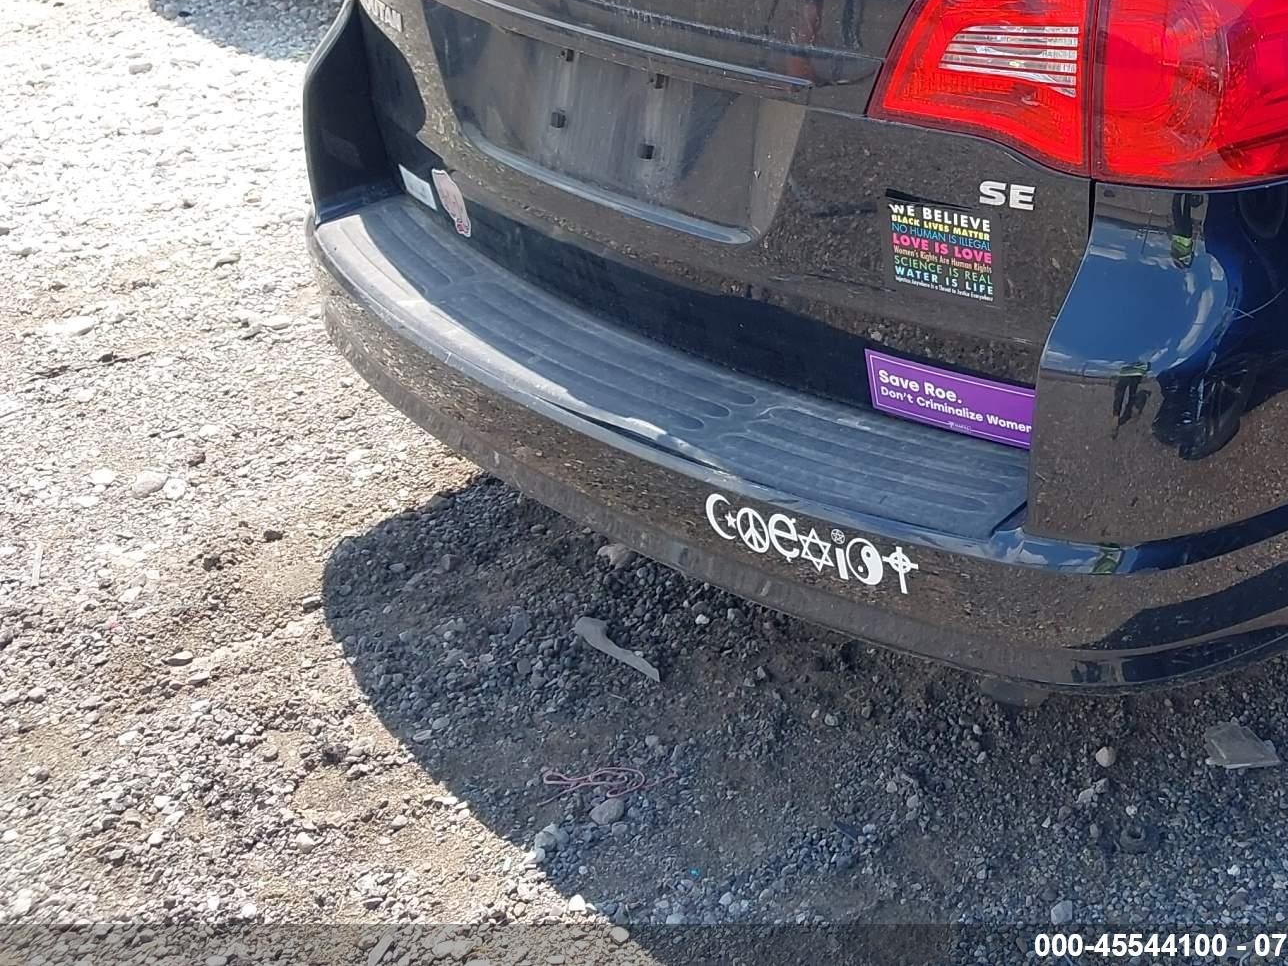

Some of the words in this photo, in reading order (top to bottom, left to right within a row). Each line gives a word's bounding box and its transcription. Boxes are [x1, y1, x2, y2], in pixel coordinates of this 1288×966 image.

[979, 180, 1037, 211] SE
[889, 204, 915, 217] WE
[923, 207, 991, 232] BELIEVE
[891, 214, 920, 227] BLACK
[924, 220, 949, 232] LIVES
[953, 227, 991, 241] MATTER
[892, 222, 907, 233] NO
[910, 225, 945, 242] HUMAN
[949, 233, 957, 244] IS
[959, 236, 992, 251] ILLEGAL
[893, 233, 928, 251] LOVE
[935, 242, 949, 255] IS
[954, 246, 992, 264] LOVE
[893, 245, 919, 258] Women's
[920, 251, 938, 263] Rights
[940, 256, 949, 265] Are
[894, 255, 943, 274] SCIENCE
[949, 266, 960, 278] IS
[965, 270, 993, 285] REAL
[895, 266, 938, 284] WATER
[945, 277, 958, 288] IS
[966, 282, 994, 295] LIFE
[879, 369, 919, 392] Save
[924, 381, 963, 404] Roe.
[881, 386, 914, 404] Don't
[917, 395, 984, 422] Criminalize
